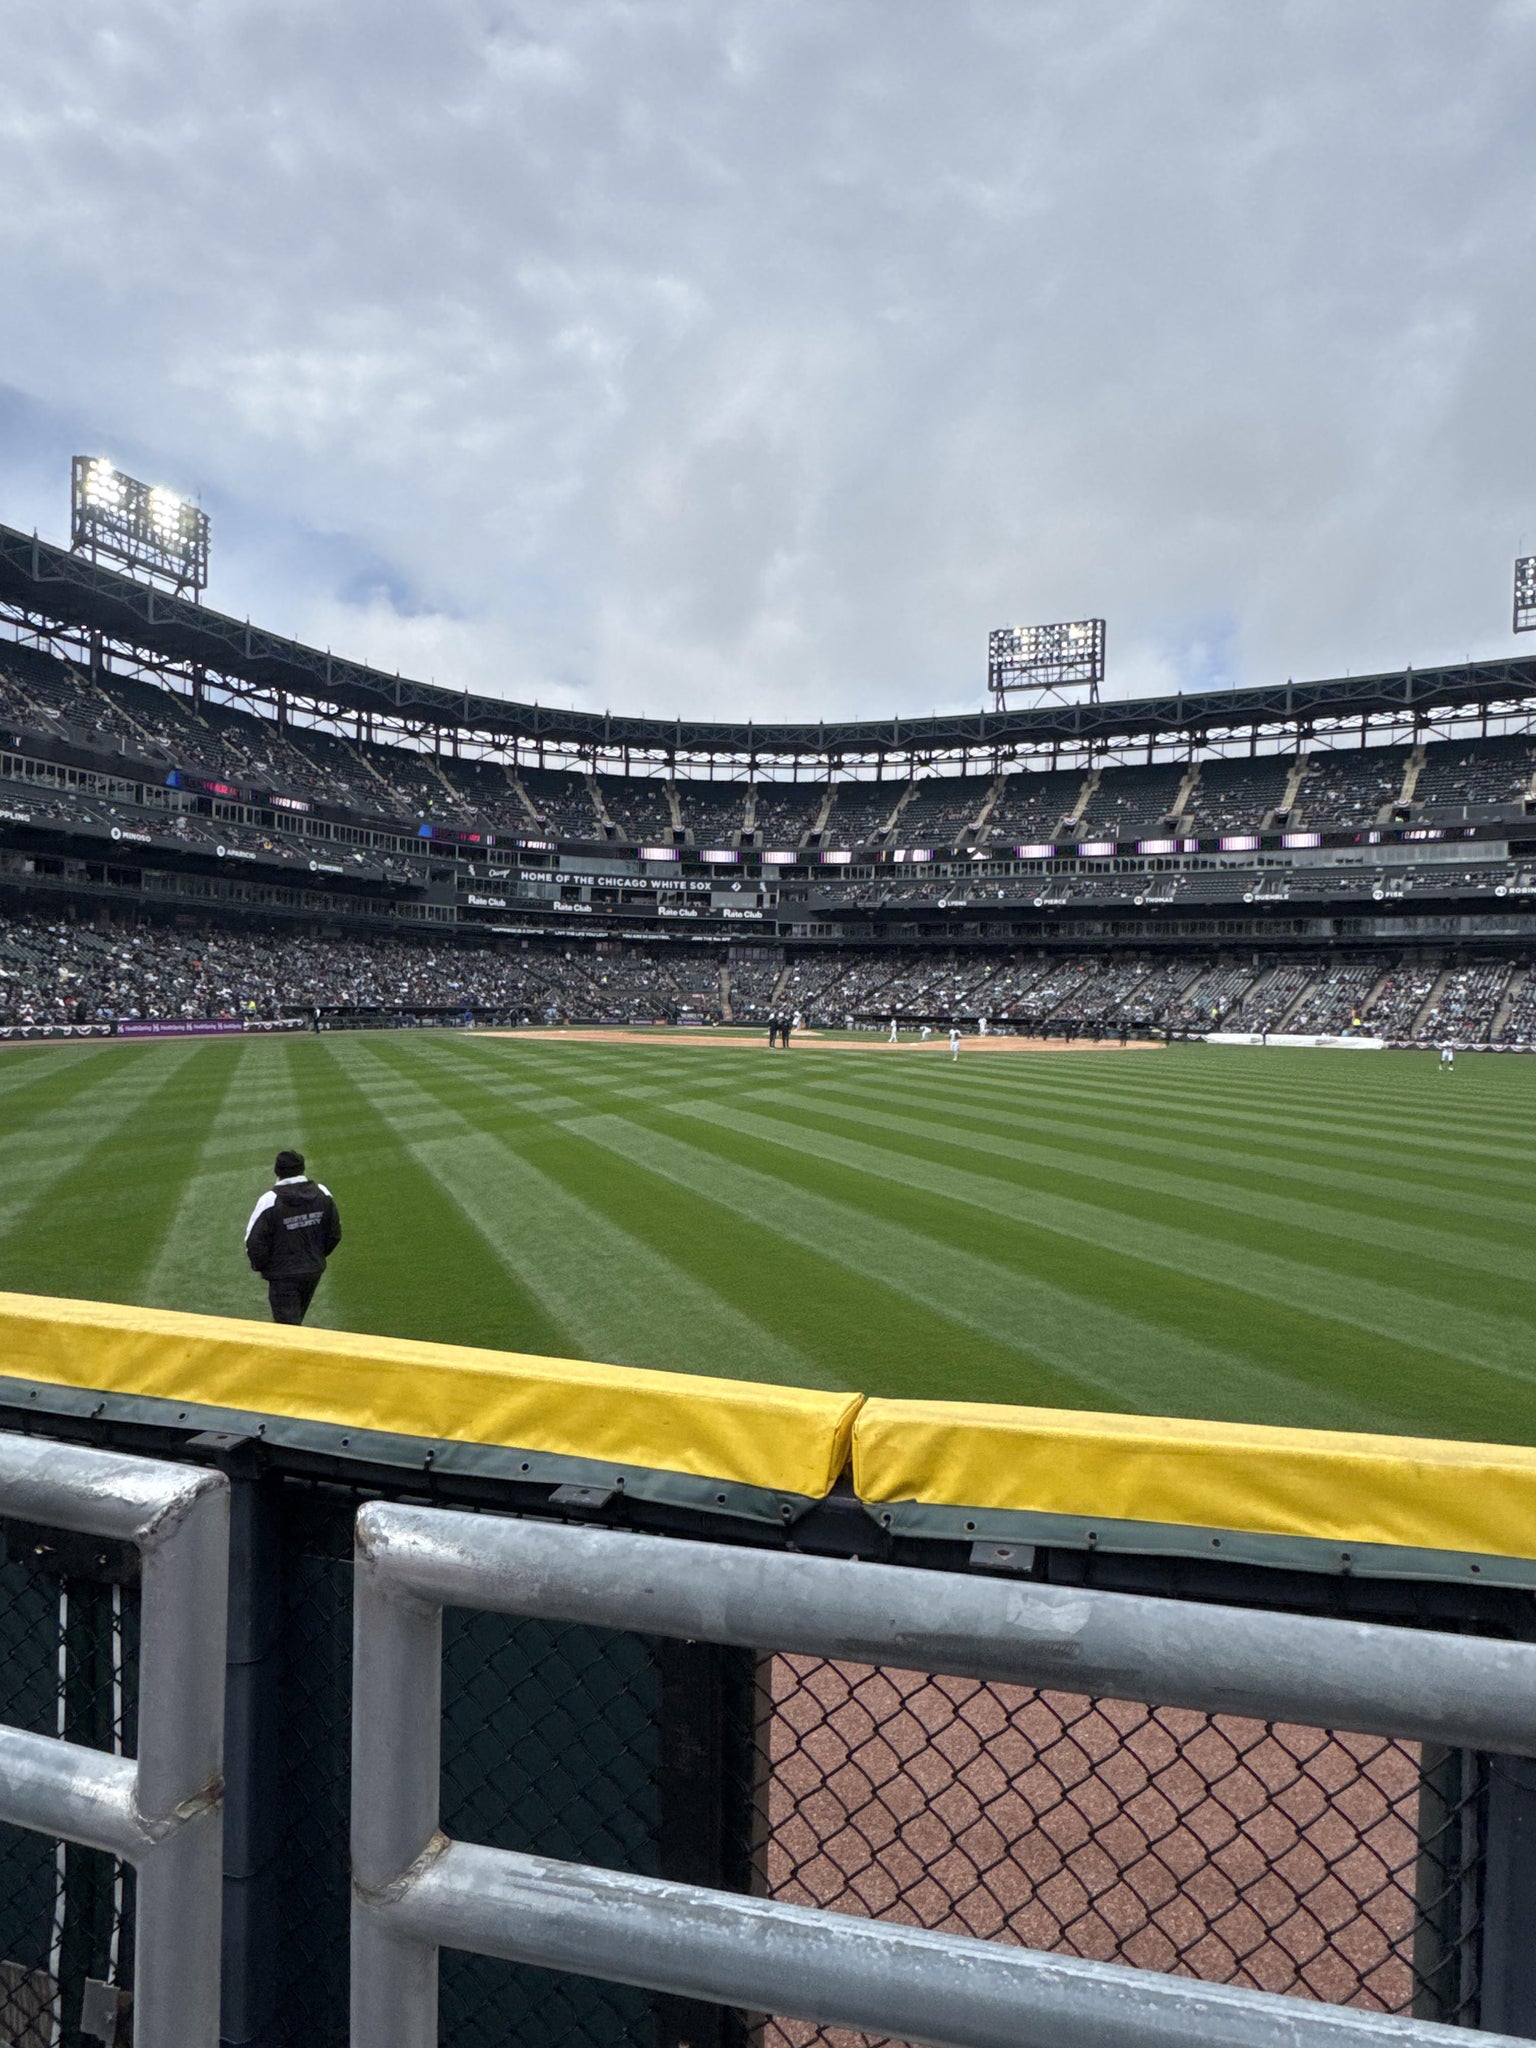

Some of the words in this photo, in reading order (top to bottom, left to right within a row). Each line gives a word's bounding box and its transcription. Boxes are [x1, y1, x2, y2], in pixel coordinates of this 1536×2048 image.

[122, 832, 152, 842] MINOSO
[226, 850, 256, 860] APARICIO
[521, 872, 552, 882] HOME
[556, 874, 570, 883] OF
[574, 876, 594, 885] THE
[598, 878, 647, 888] CHICAGO
[650, 880, 686, 889] WHITE
[690, 882, 712, 890] SOX
[468, 895, 487, 905] Rate
[488, 898, 506, 906] Club
[554, 901, 572, 911] Rate
[574, 904, 592, 912] Club
[658, 907, 678, 916] Rate
[723, 909, 743, 918] Rate
[744, 910, 762, 918] Club
